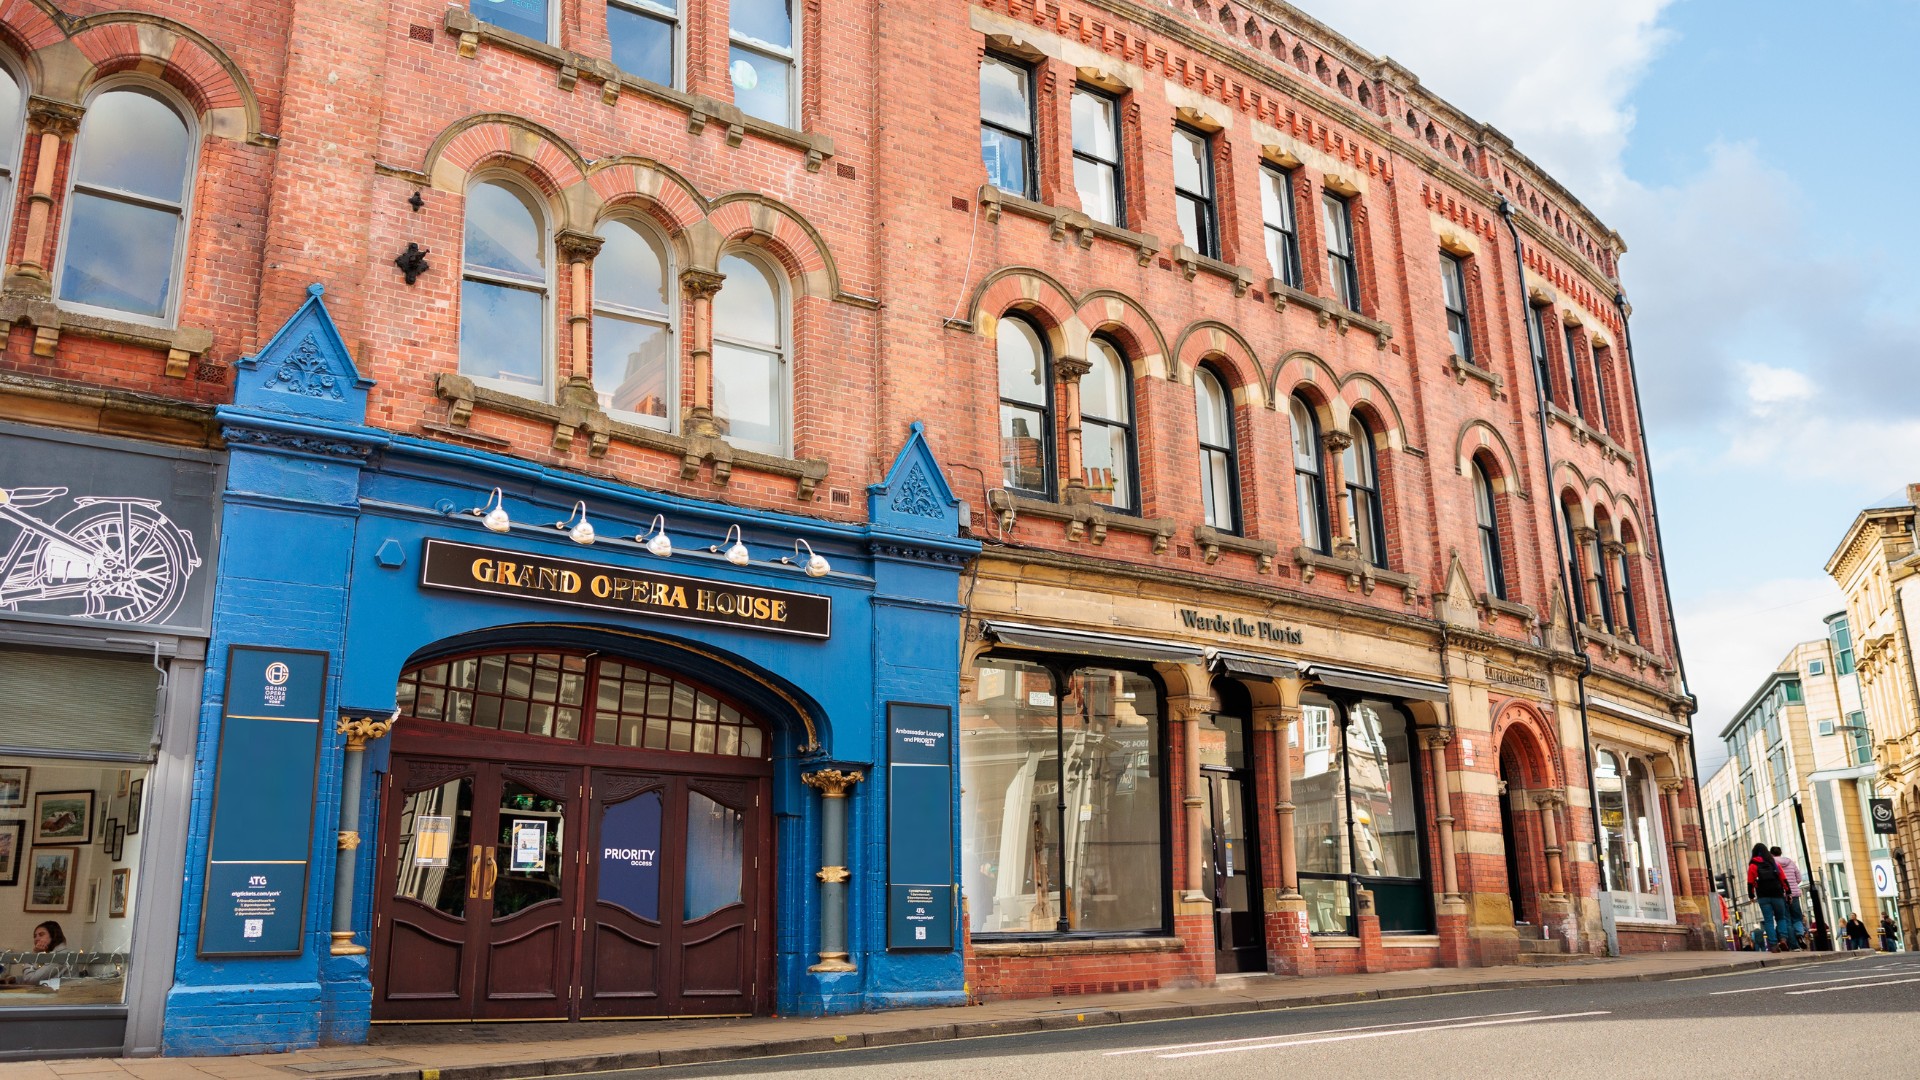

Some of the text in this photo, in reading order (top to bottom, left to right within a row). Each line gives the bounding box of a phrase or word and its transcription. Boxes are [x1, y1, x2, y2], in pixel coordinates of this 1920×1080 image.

[472, 558, 787, 623] GRAND OPERA HOUSE
[1180, 609, 1304, 644] Wards the Florist
[604, 848, 655, 860] PRIORITY
[248, 876, 267, 885] ATG
